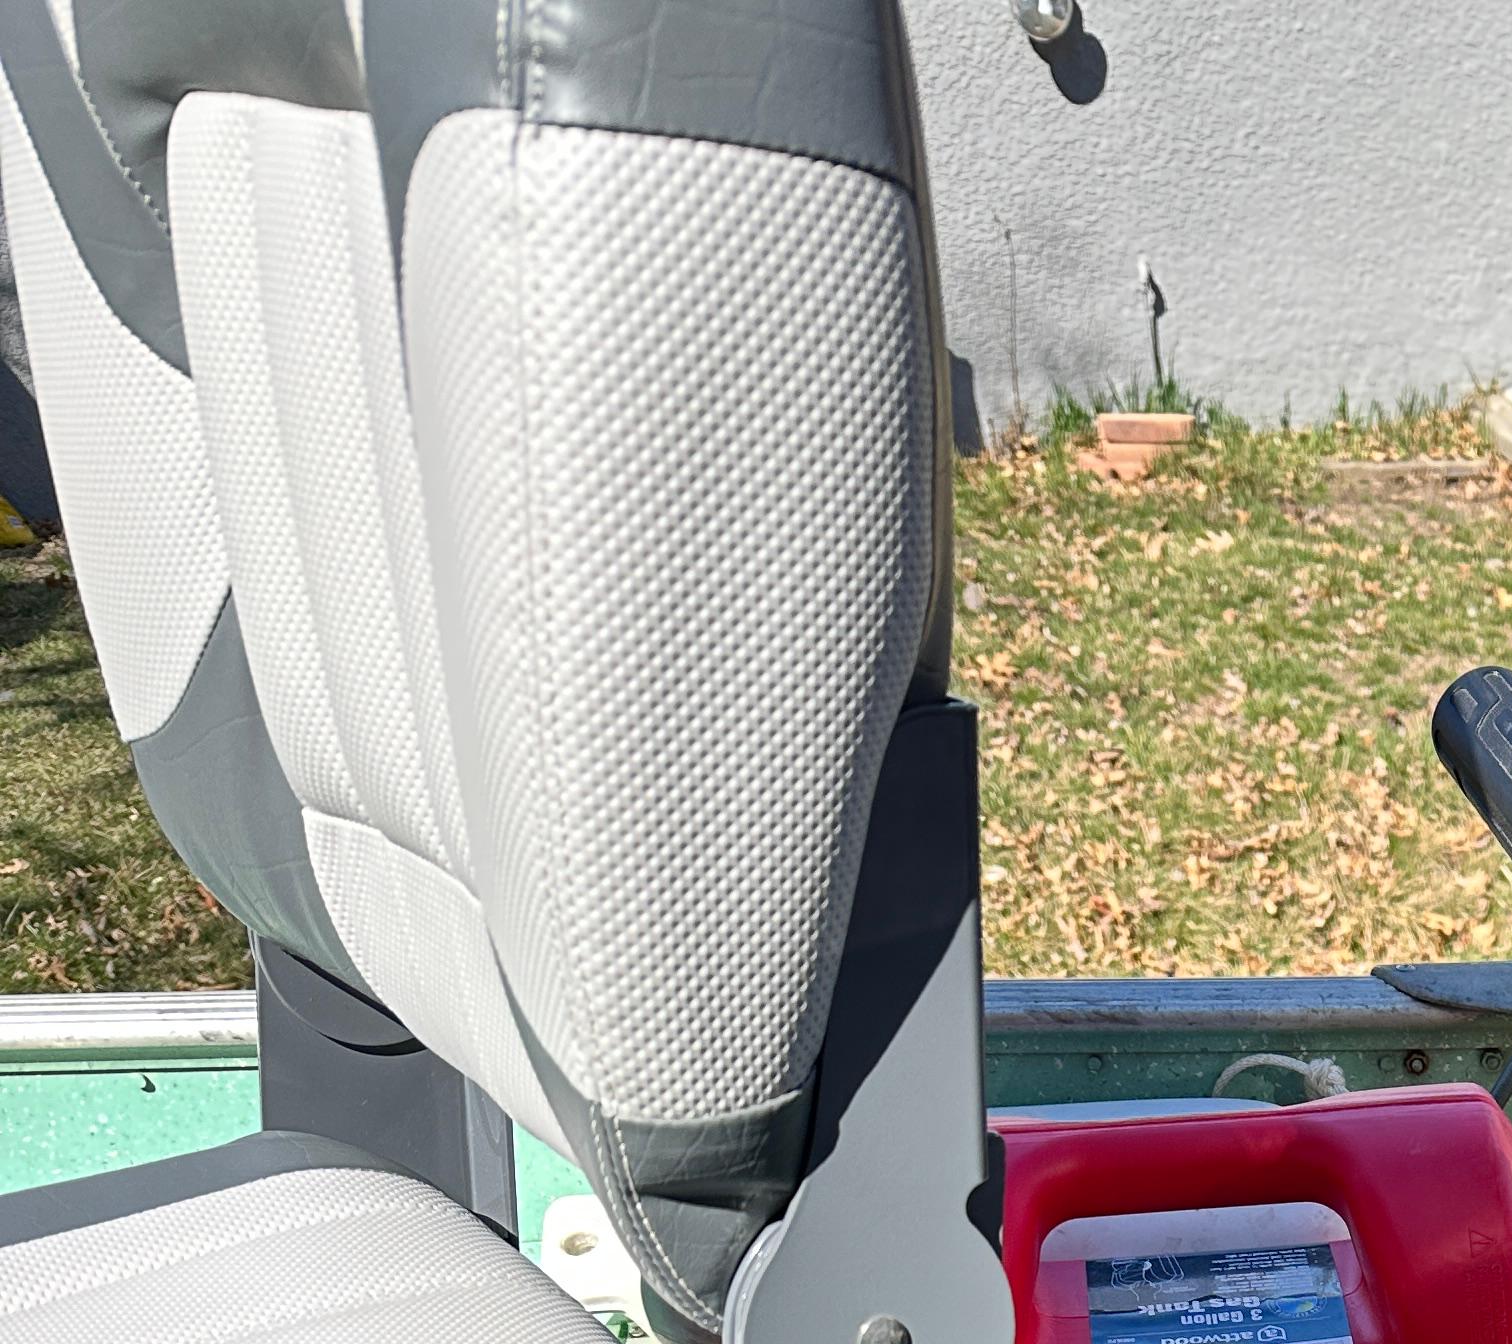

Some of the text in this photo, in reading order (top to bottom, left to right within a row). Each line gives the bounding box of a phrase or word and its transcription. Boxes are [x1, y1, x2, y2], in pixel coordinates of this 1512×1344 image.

[1137, 1299, 1205, 1316] Tank
[1207, 1296, 1261, 1311] Gas
[1180, 1309, 1263, 1326] 3 Gallon
